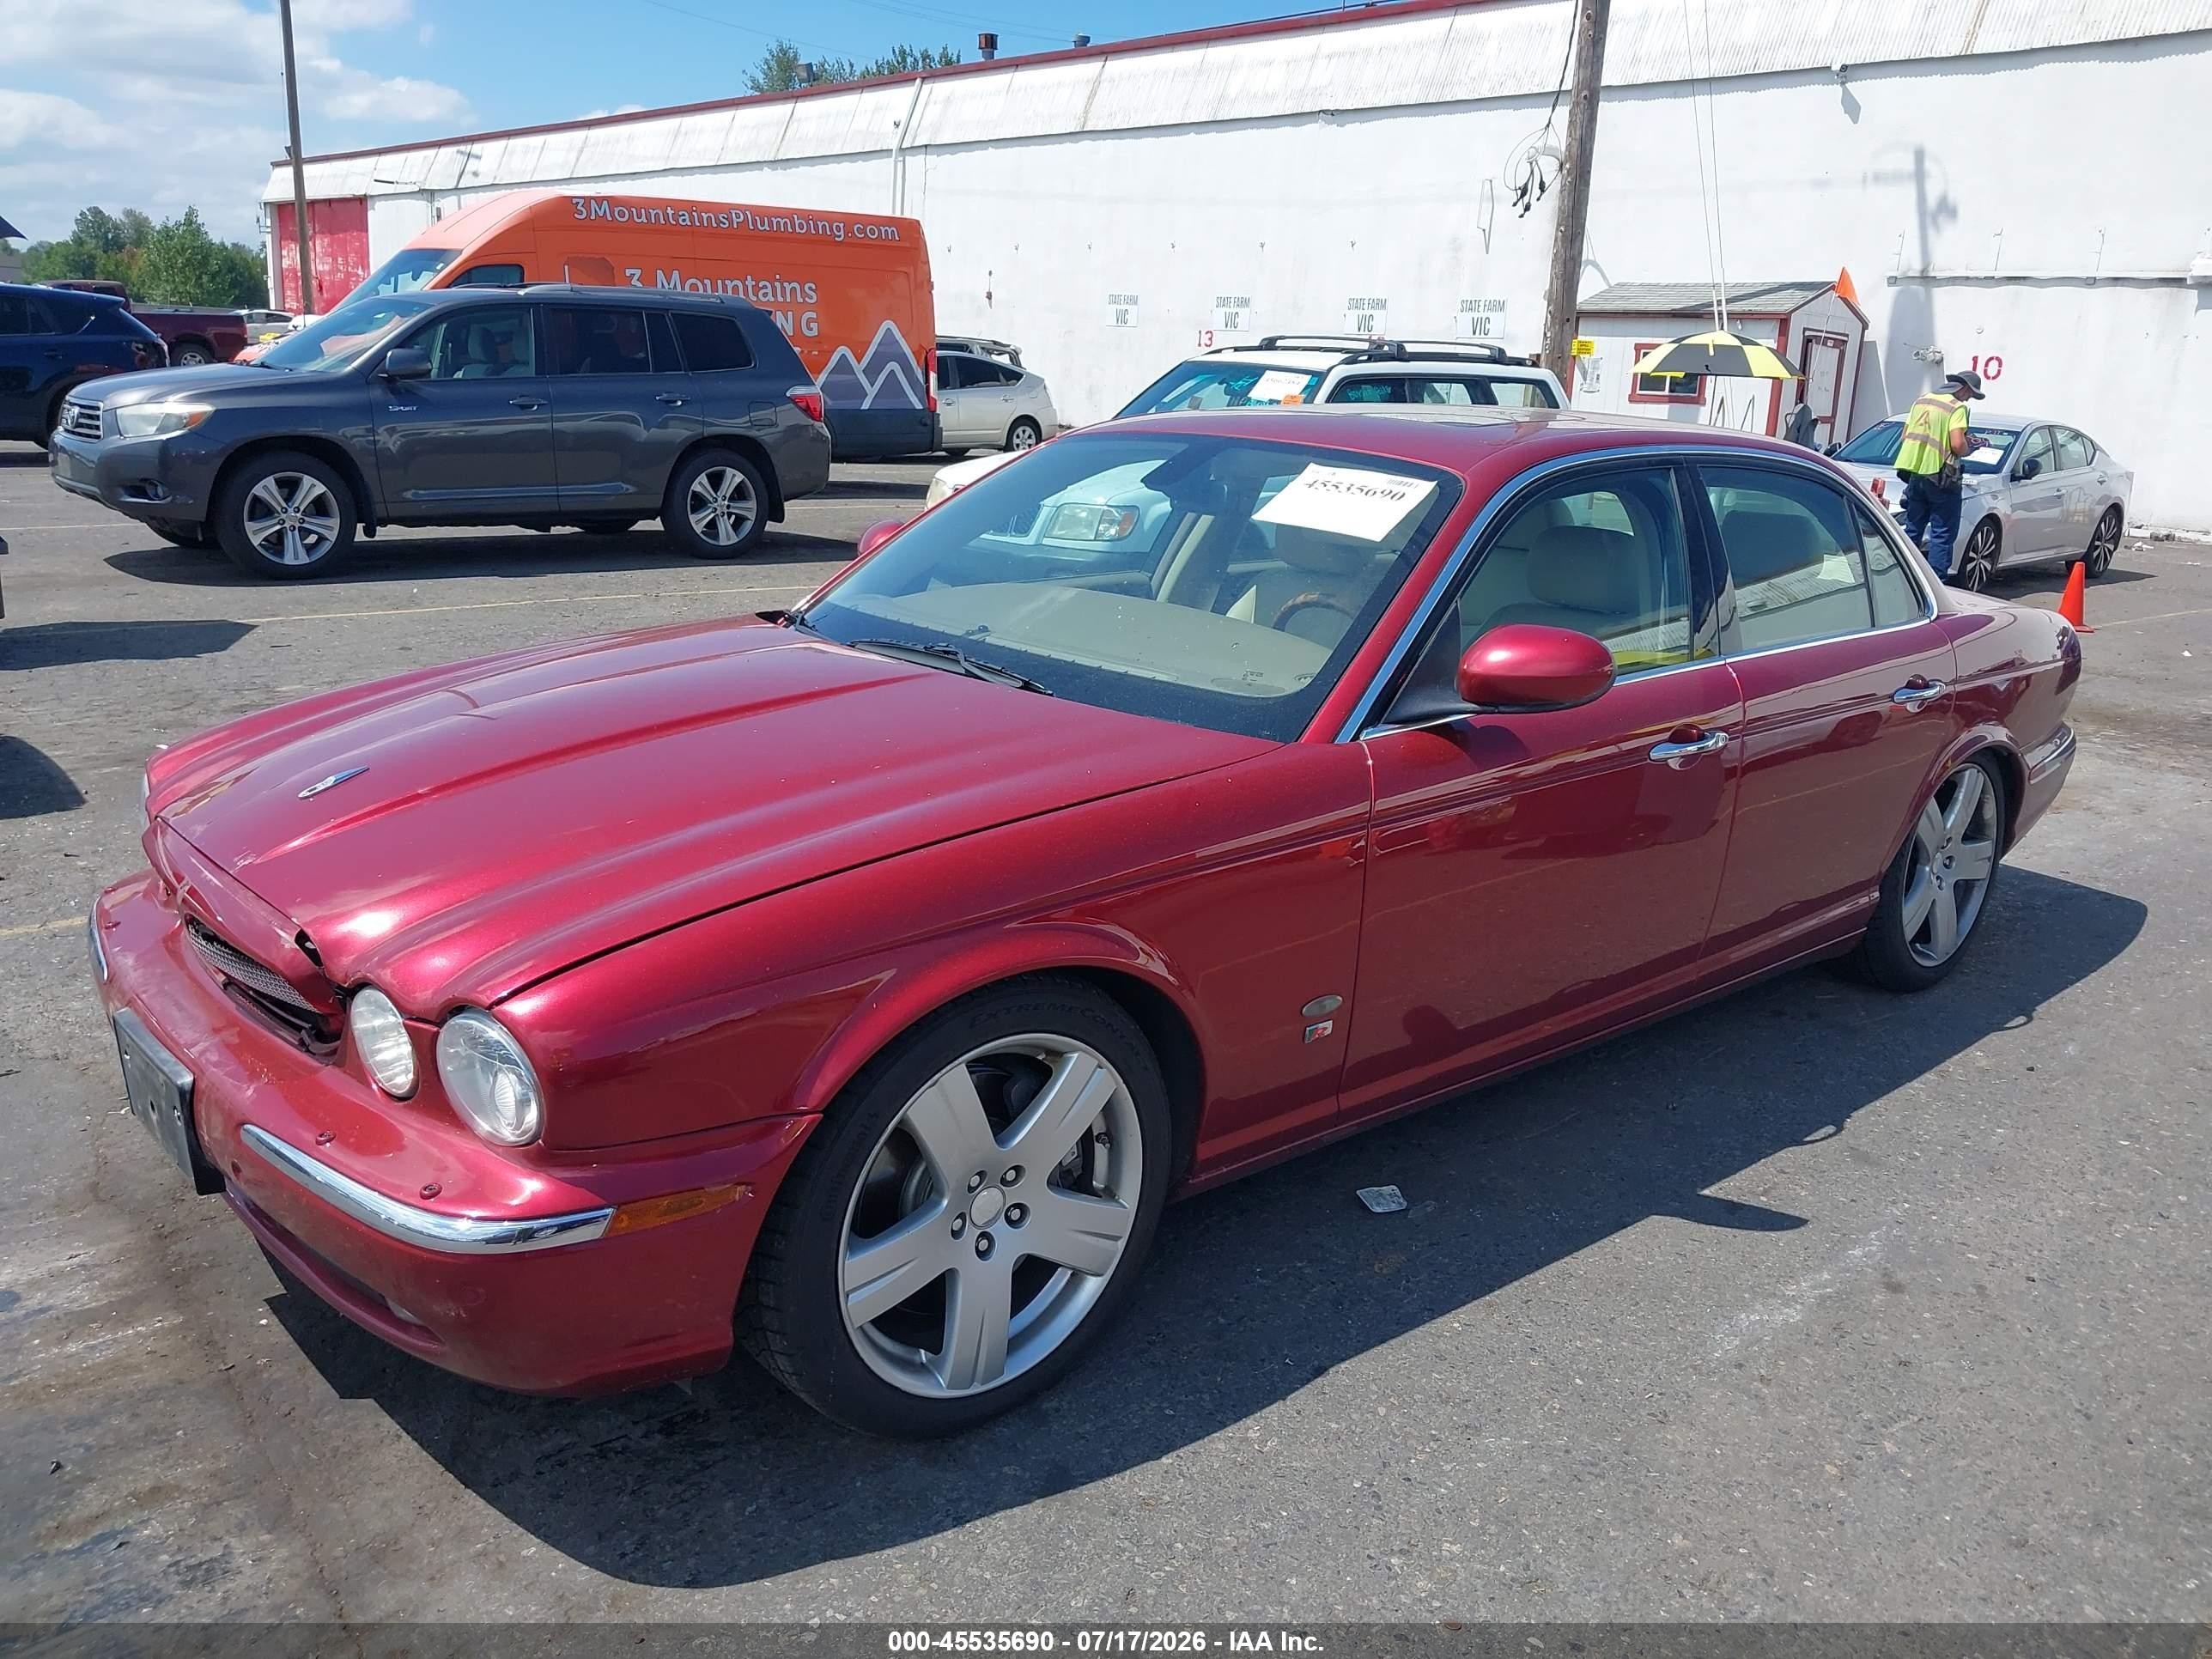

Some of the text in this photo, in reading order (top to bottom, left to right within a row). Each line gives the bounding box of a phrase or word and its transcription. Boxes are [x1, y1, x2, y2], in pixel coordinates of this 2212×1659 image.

[571, 197, 901, 241] 3MountainsPlumbing.com
[624, 268, 818, 304] 3 Mountains
[1108, 294, 1139, 307] STATE FARM
[1215, 296, 1250, 309] STATE FARM
[1347, 297, 1387, 311] STATE FARM
[1460, 299, 1505, 313] STATE FARM
[1115, 308, 1129, 325] VIC
[1224, 311, 1239, 329] VIC
[1357, 313, 1374, 332] VIC
[1472, 316, 1491, 336] VIC
[1197, 330, 1213, 348] 13
[1972, 355, 2002, 380] 10
[1304, 479, 1406, 501] 45535690
